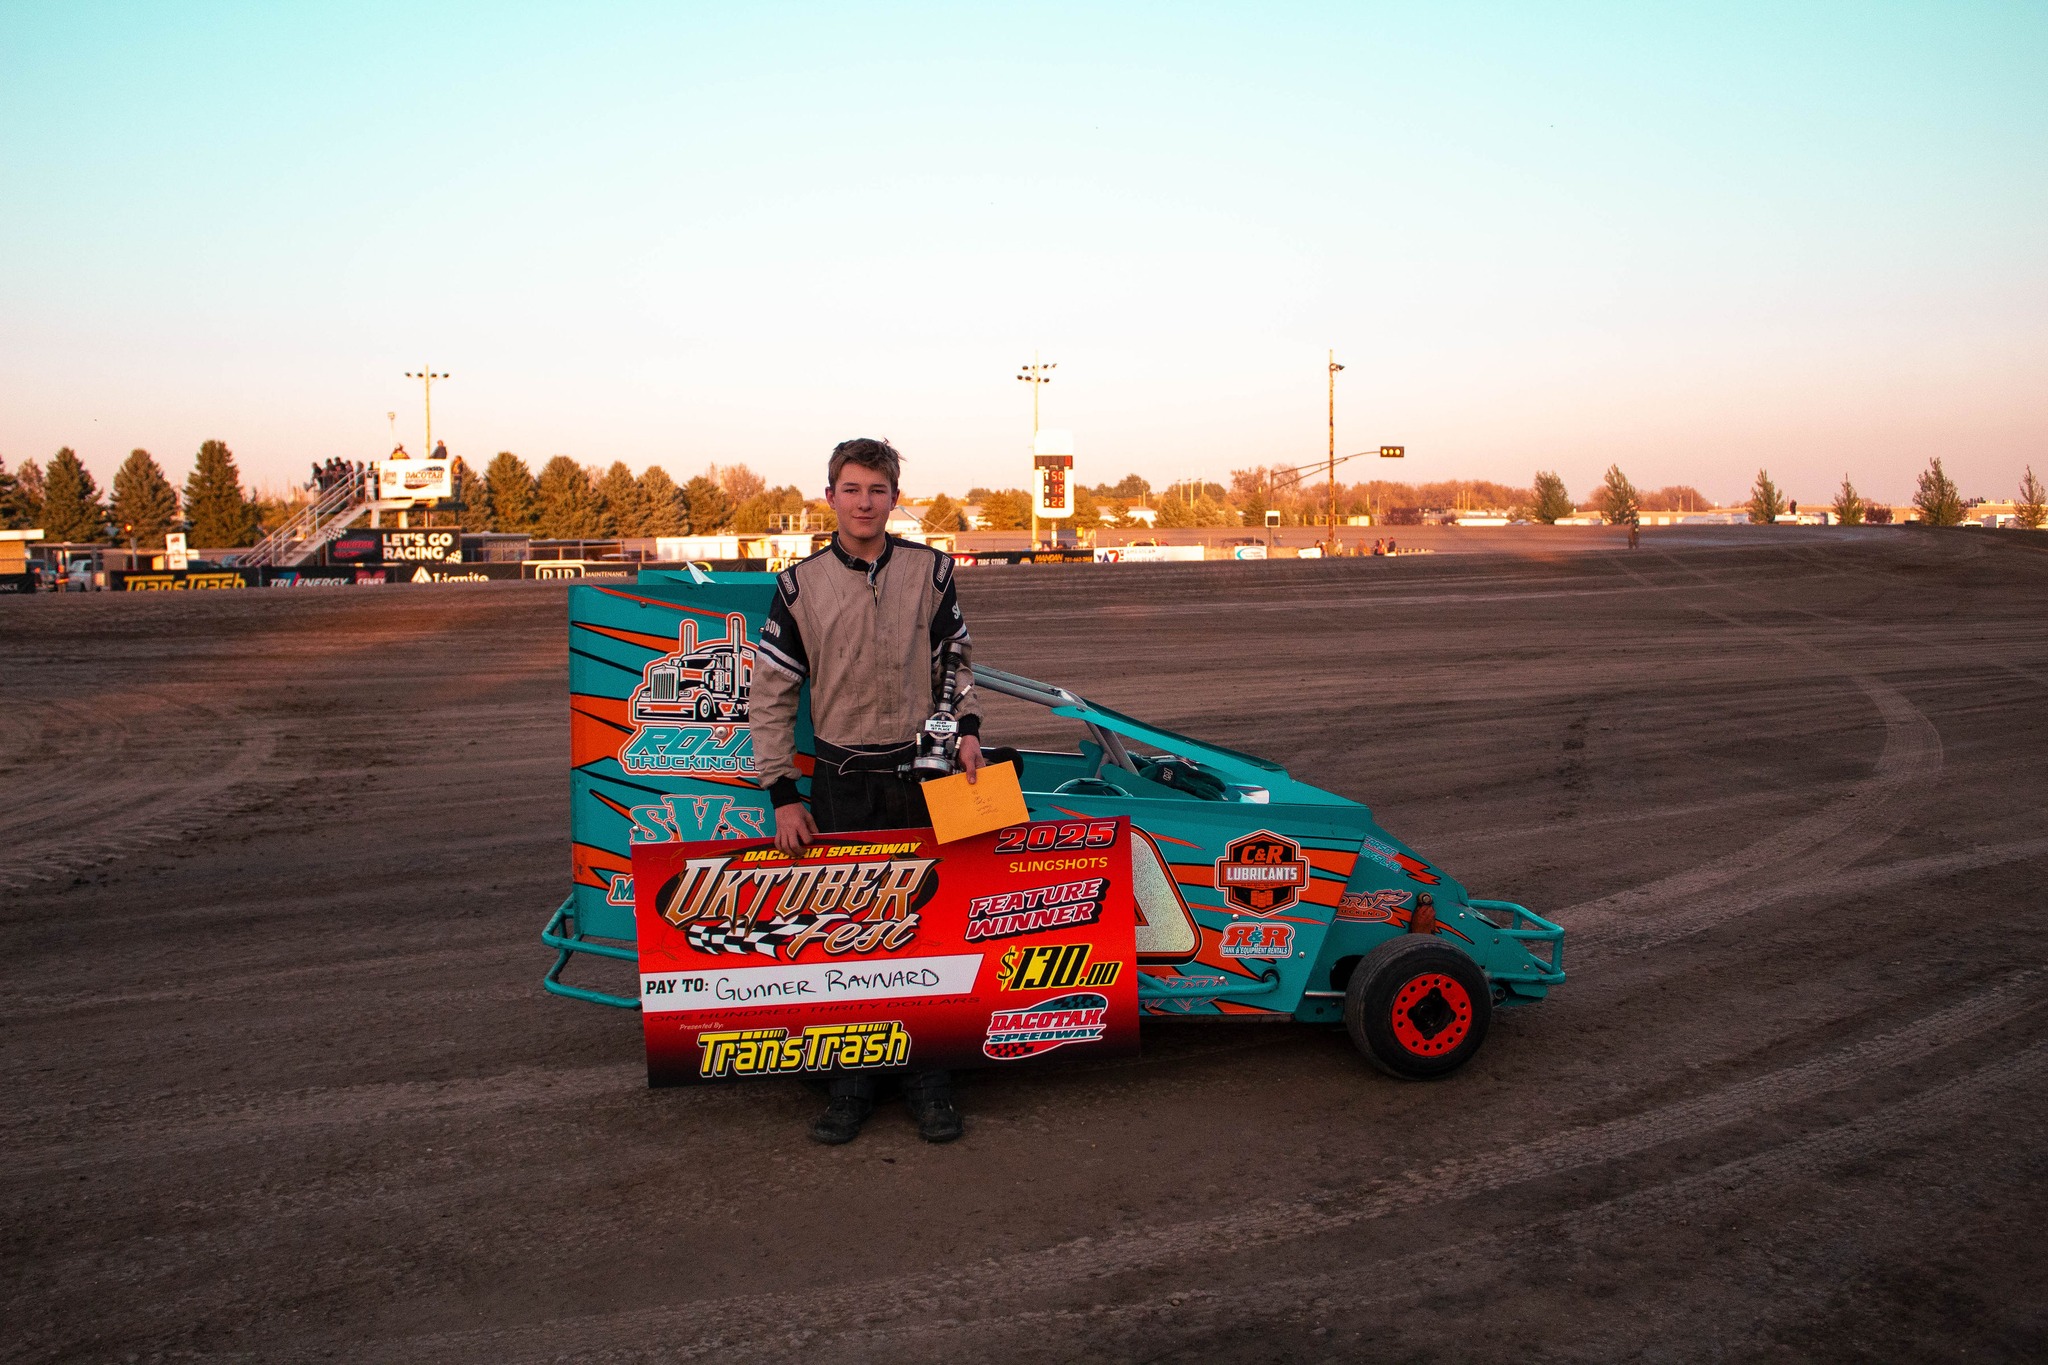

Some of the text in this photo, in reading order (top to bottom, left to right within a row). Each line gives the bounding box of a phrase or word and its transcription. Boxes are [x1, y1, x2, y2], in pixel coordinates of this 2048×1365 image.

[405, 471, 444, 479] DACOTAH
[1051, 470, 1064, 481] 50
[1051, 497, 1064, 507] 22
[382, 533, 453, 547] LET'S GO
[383, 547, 444, 560] RACING
[296, 578, 348, 587] ENERGY
[627, 756, 735, 770] TRUCKING
[994, 821, 1117, 853] 2025
[826, 842, 922, 857] SPEEDWAY
[1241, 845, 1284, 865] C&R
[1009, 857, 1109, 873] SLINGSHOTS
[1227, 867, 1297, 881] LUBRICANTS
[664, 857, 939, 930] OKTOBER
[968, 877, 1104, 919] FEATURE
[965, 901, 1096, 940] WINNER
[786, 912, 921, 960] Fest
[1222, 947, 1235, 955] TANK
[1240, 947, 1267, 955] EQUIPMENT
[1267, 947, 1288, 955] RENTALS
[997, 943, 1122, 992] $130.00
[646, 978, 709, 995] PAY TO:
[825, 968, 940, 993] RAYNARD
[650, 1013, 688, 1022] ONE
[698, 1007, 801, 1021] HUNDRED
[887, 995, 981, 1009] DOLLARS
[679, 1021, 712, 1030] Presented
[988, 1009, 1104, 1031] DACOTAH
[990, 1028, 1101, 1043] SPEEDWAY
[699, 1022, 908, 1075] TransTrash
